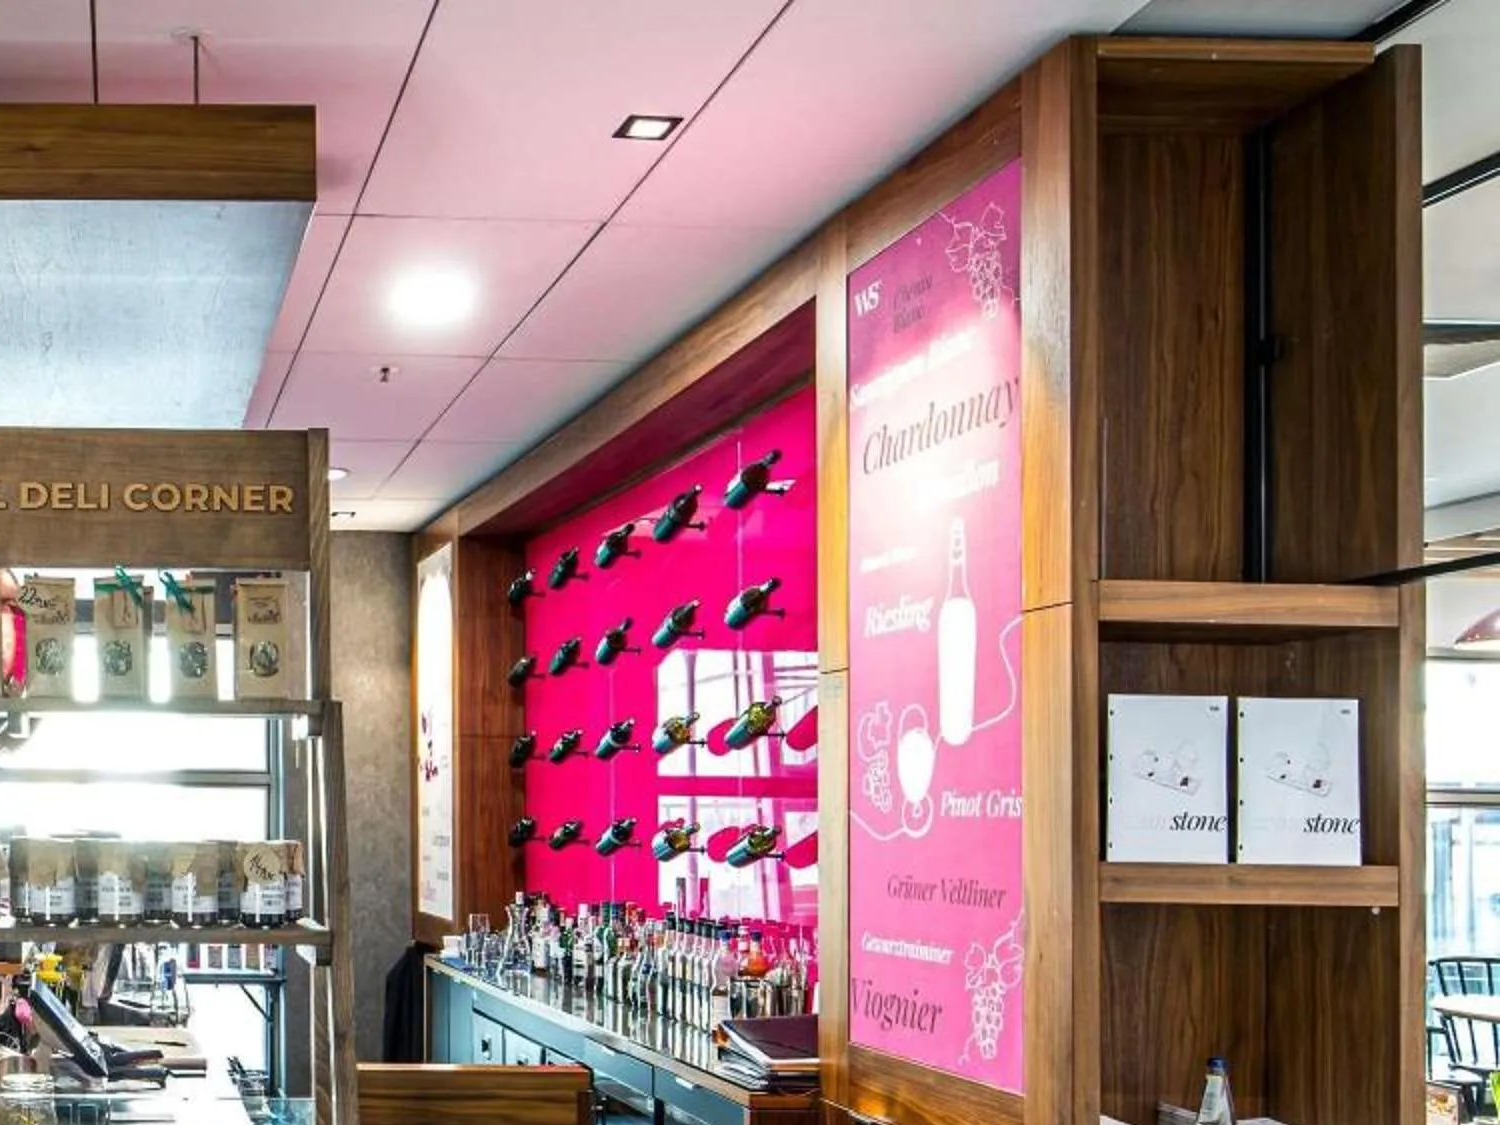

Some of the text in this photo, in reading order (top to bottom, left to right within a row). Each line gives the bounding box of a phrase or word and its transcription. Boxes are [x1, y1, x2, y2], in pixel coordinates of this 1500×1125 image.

[854, 280, 882, 318] WS
[863, 376, 1019, 475] Chardonnay
[19, 481, 110, 511] DELI
[123, 482, 294, 514] CORNER
[864, 596, 934, 638] Riesling
[941, 788, 1024, 818] Pinot Gris
[1169, 811, 1228, 832] stone
[1303, 812, 1362, 835] stone
[887, 873, 1007, 909] Grüner Veltliner
[851, 976, 943, 1034] Viognier
